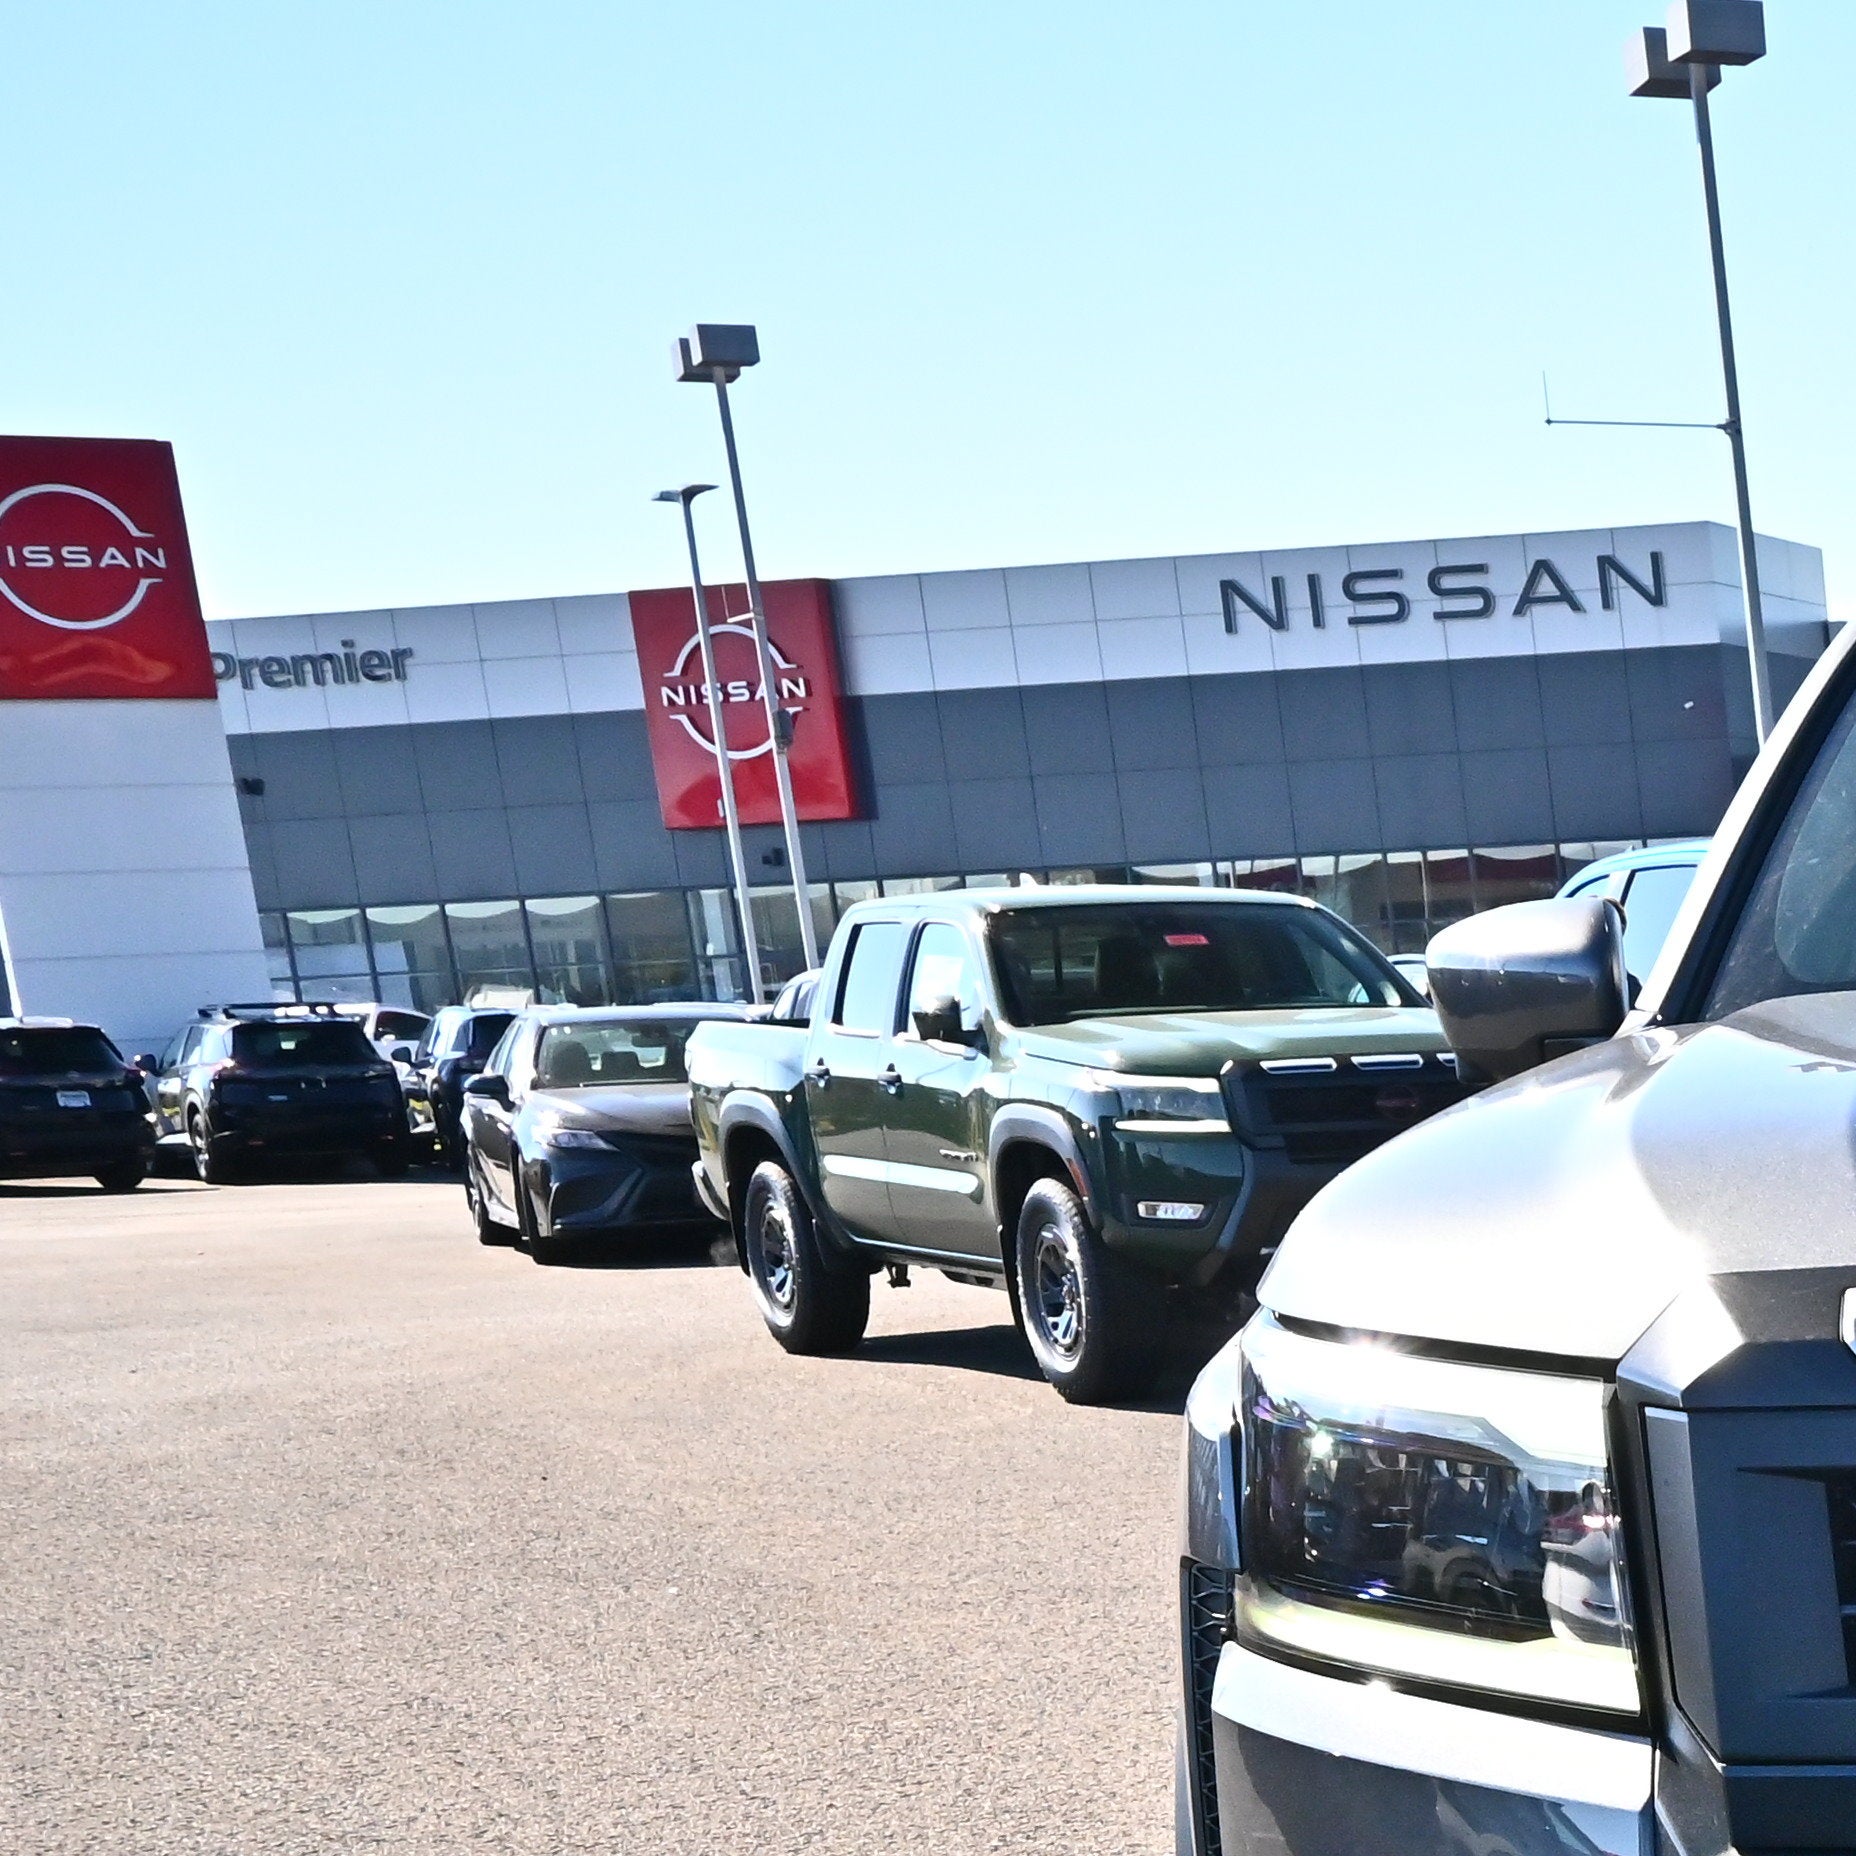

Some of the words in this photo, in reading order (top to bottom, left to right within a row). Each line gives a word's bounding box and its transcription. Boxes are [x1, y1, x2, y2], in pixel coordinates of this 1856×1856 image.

[5, 545, 167, 569] ISSAN
[1219, 551, 1668, 634] NISSAN
[211, 638, 414, 690] Premier
